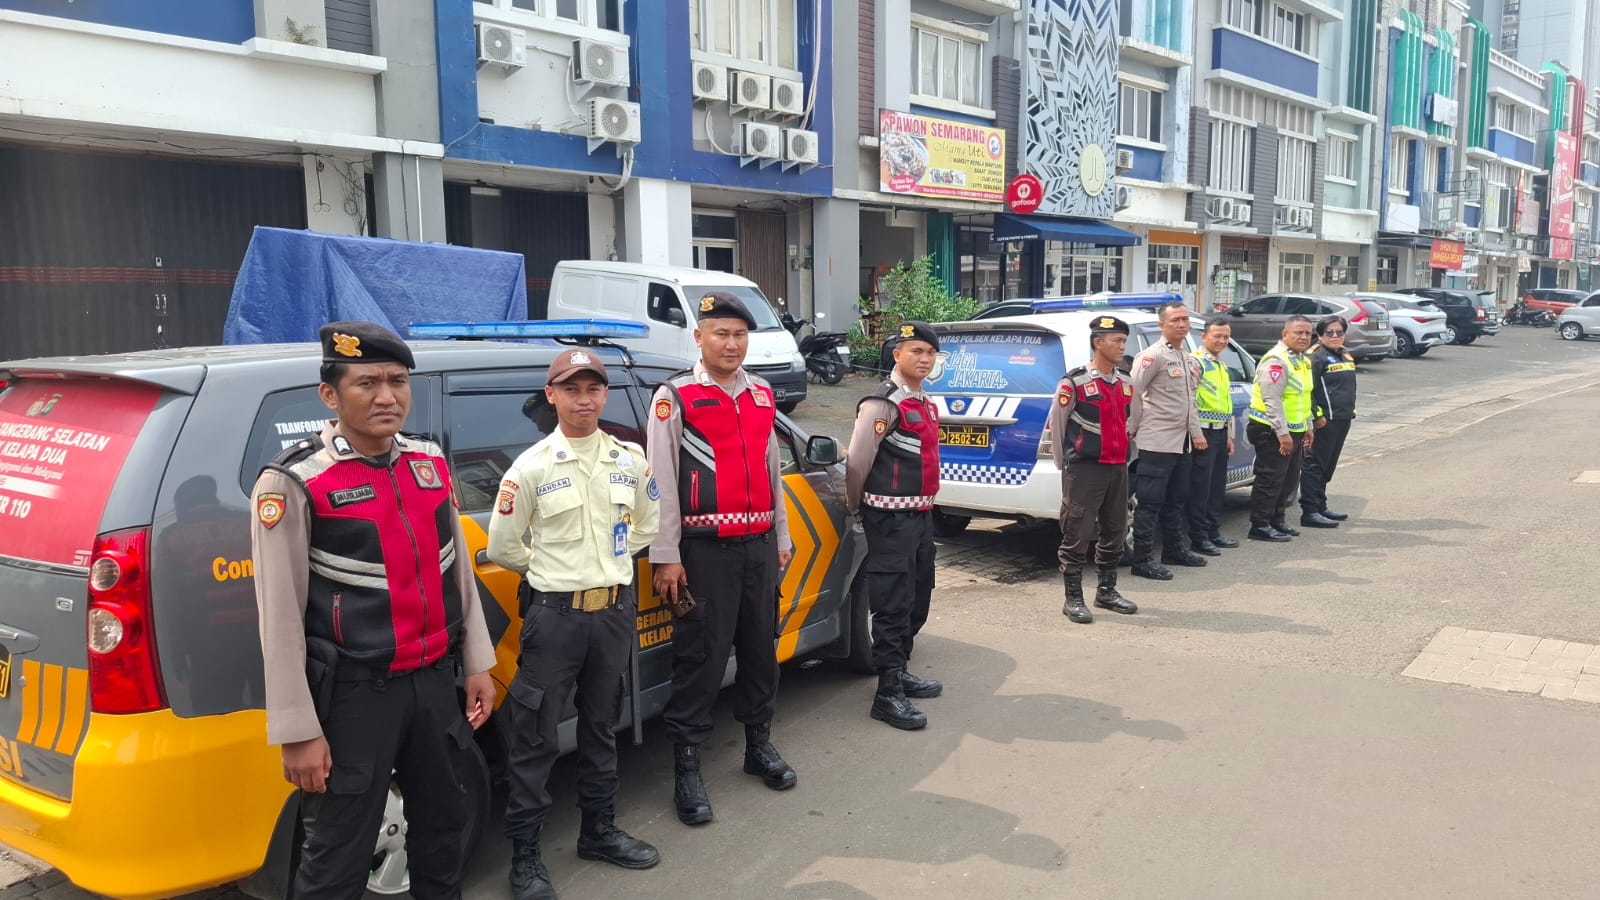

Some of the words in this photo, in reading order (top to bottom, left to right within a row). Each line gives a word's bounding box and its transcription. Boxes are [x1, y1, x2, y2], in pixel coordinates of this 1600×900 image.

[889, 115, 927, 135] PAWON
[931, 122, 985, 144] SEMARANG
[1011, 198, 1037, 208] gofood
[938, 334, 960, 344] ANTAS
[960, 334, 989, 343] POLSEK
[990, 334, 1022, 344] KELAPA
[1023, 335, 1042, 345] DUA
[945, 350, 978, 370] JAGA
[0, 422, 54, 441] ANGERANG
[50, 428, 111, 451] SELATAN
[275, 420, 326, 435] TRANFORM
[949, 434, 986, 446] 2502-41
[1, 441, 40, 460] KELAPA
[38, 446, 68, 466] DUA
[9, 499, 32, 518] 110
[212, 556, 254, 581] Con
[640, 626, 674, 649] KELAP
